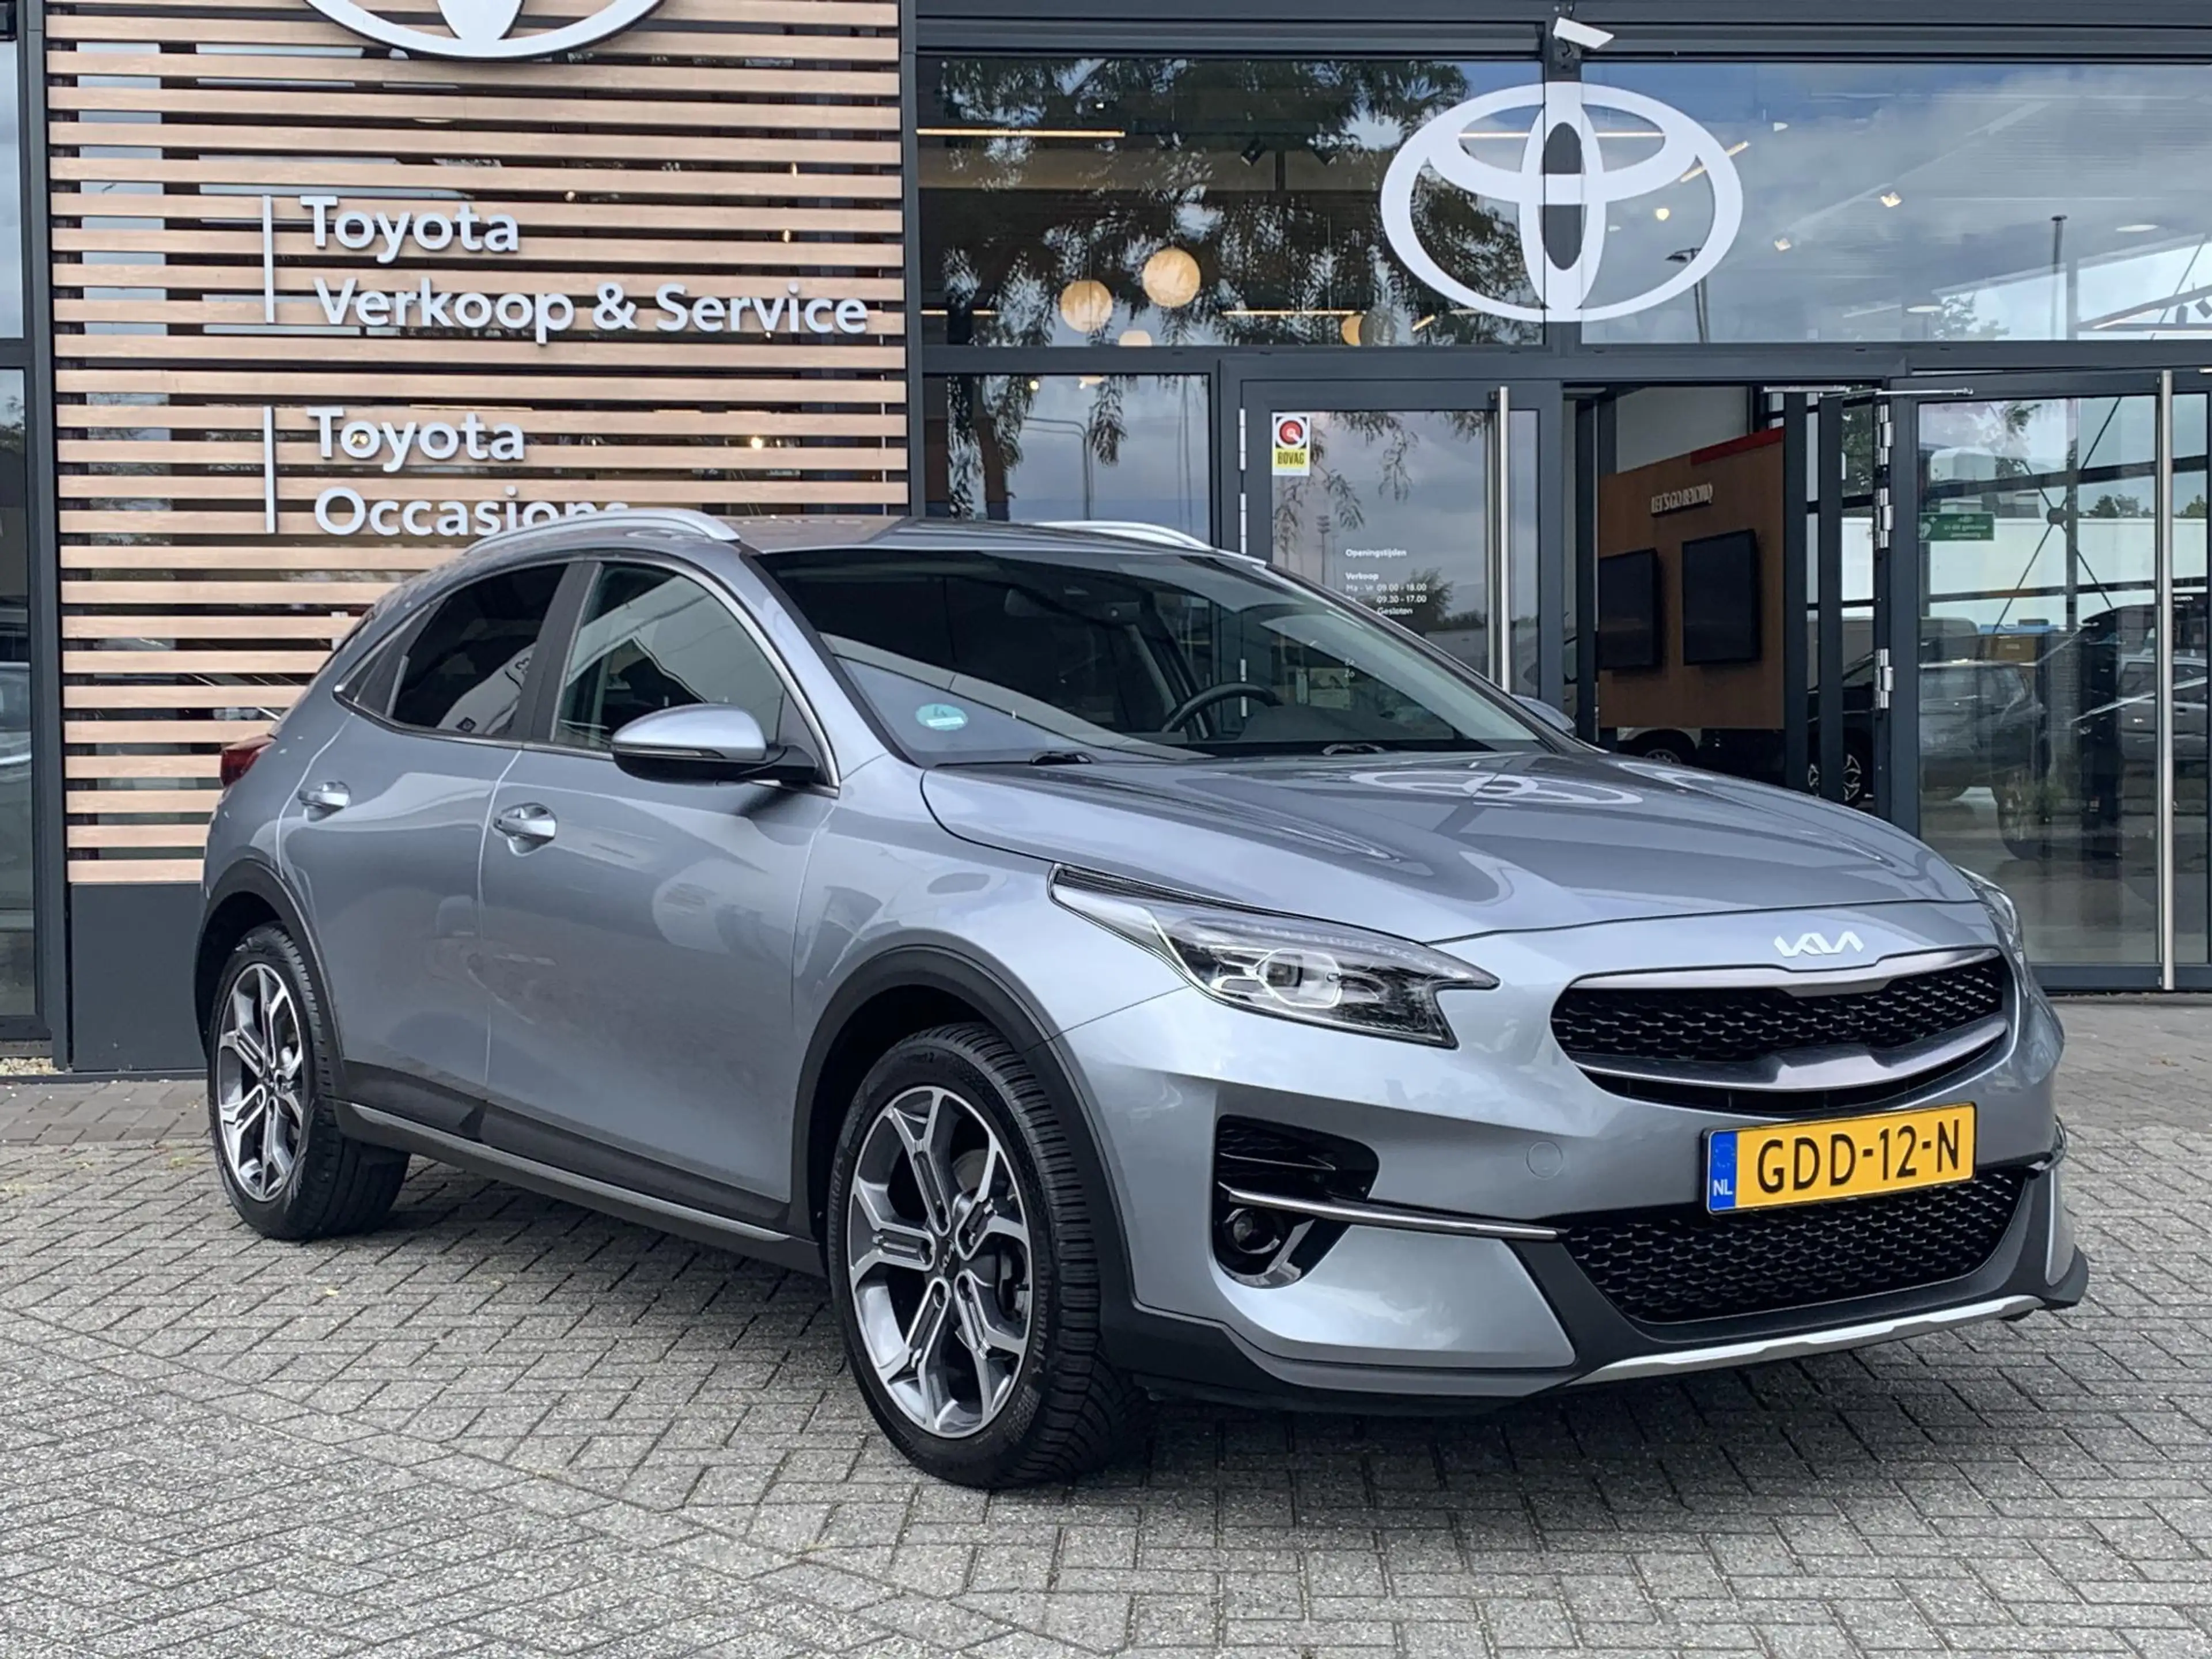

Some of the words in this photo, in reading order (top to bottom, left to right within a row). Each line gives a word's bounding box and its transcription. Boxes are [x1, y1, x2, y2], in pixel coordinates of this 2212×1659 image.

[299, 195, 519, 264] Toyota
[313, 276, 574, 346] Verkoop
[592, 281, 637, 331] &
[656, 279, 868, 334] Service
[306, 406, 525, 473] Toyota
[1277, 451, 1305, 465] BOVAG
[315, 484, 630, 537] Occasio
[1345, 548, 1407, 558] Openingstijden
[1345, 571, 1379, 581] Verkoop
[1406, 594, 1427, 603] 17.00
[1774, 931, 1864, 957] KIA
[1756, 1119, 1959, 1194] GDD-12-N
[1713, 1179, 1733, 1196] NL
